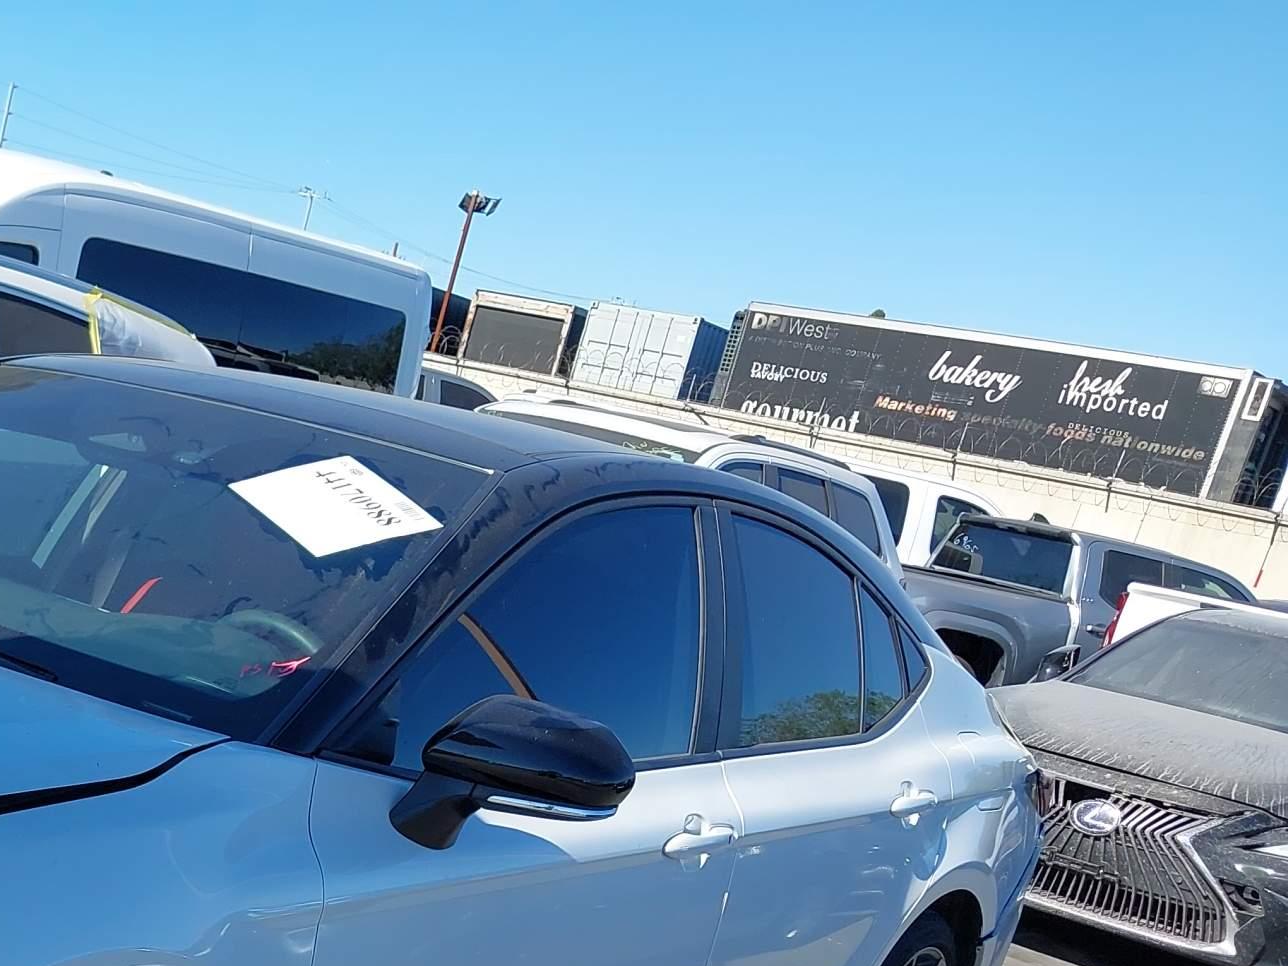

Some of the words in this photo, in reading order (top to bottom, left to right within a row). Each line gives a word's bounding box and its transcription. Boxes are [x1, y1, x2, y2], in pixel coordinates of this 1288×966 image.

[751, 361, 828, 383] DELICIOUS
[928, 350, 1023, 403] bakery
[1057, 384, 1169, 420] imported
[873, 394, 958, 422] Marketing
[1046, 422, 1096, 442] foods
[1100, 433, 1206, 461] nationwide
[1068, 422, 1130, 439] DELICIOUS
[315, 470, 402, 527] 44170988
